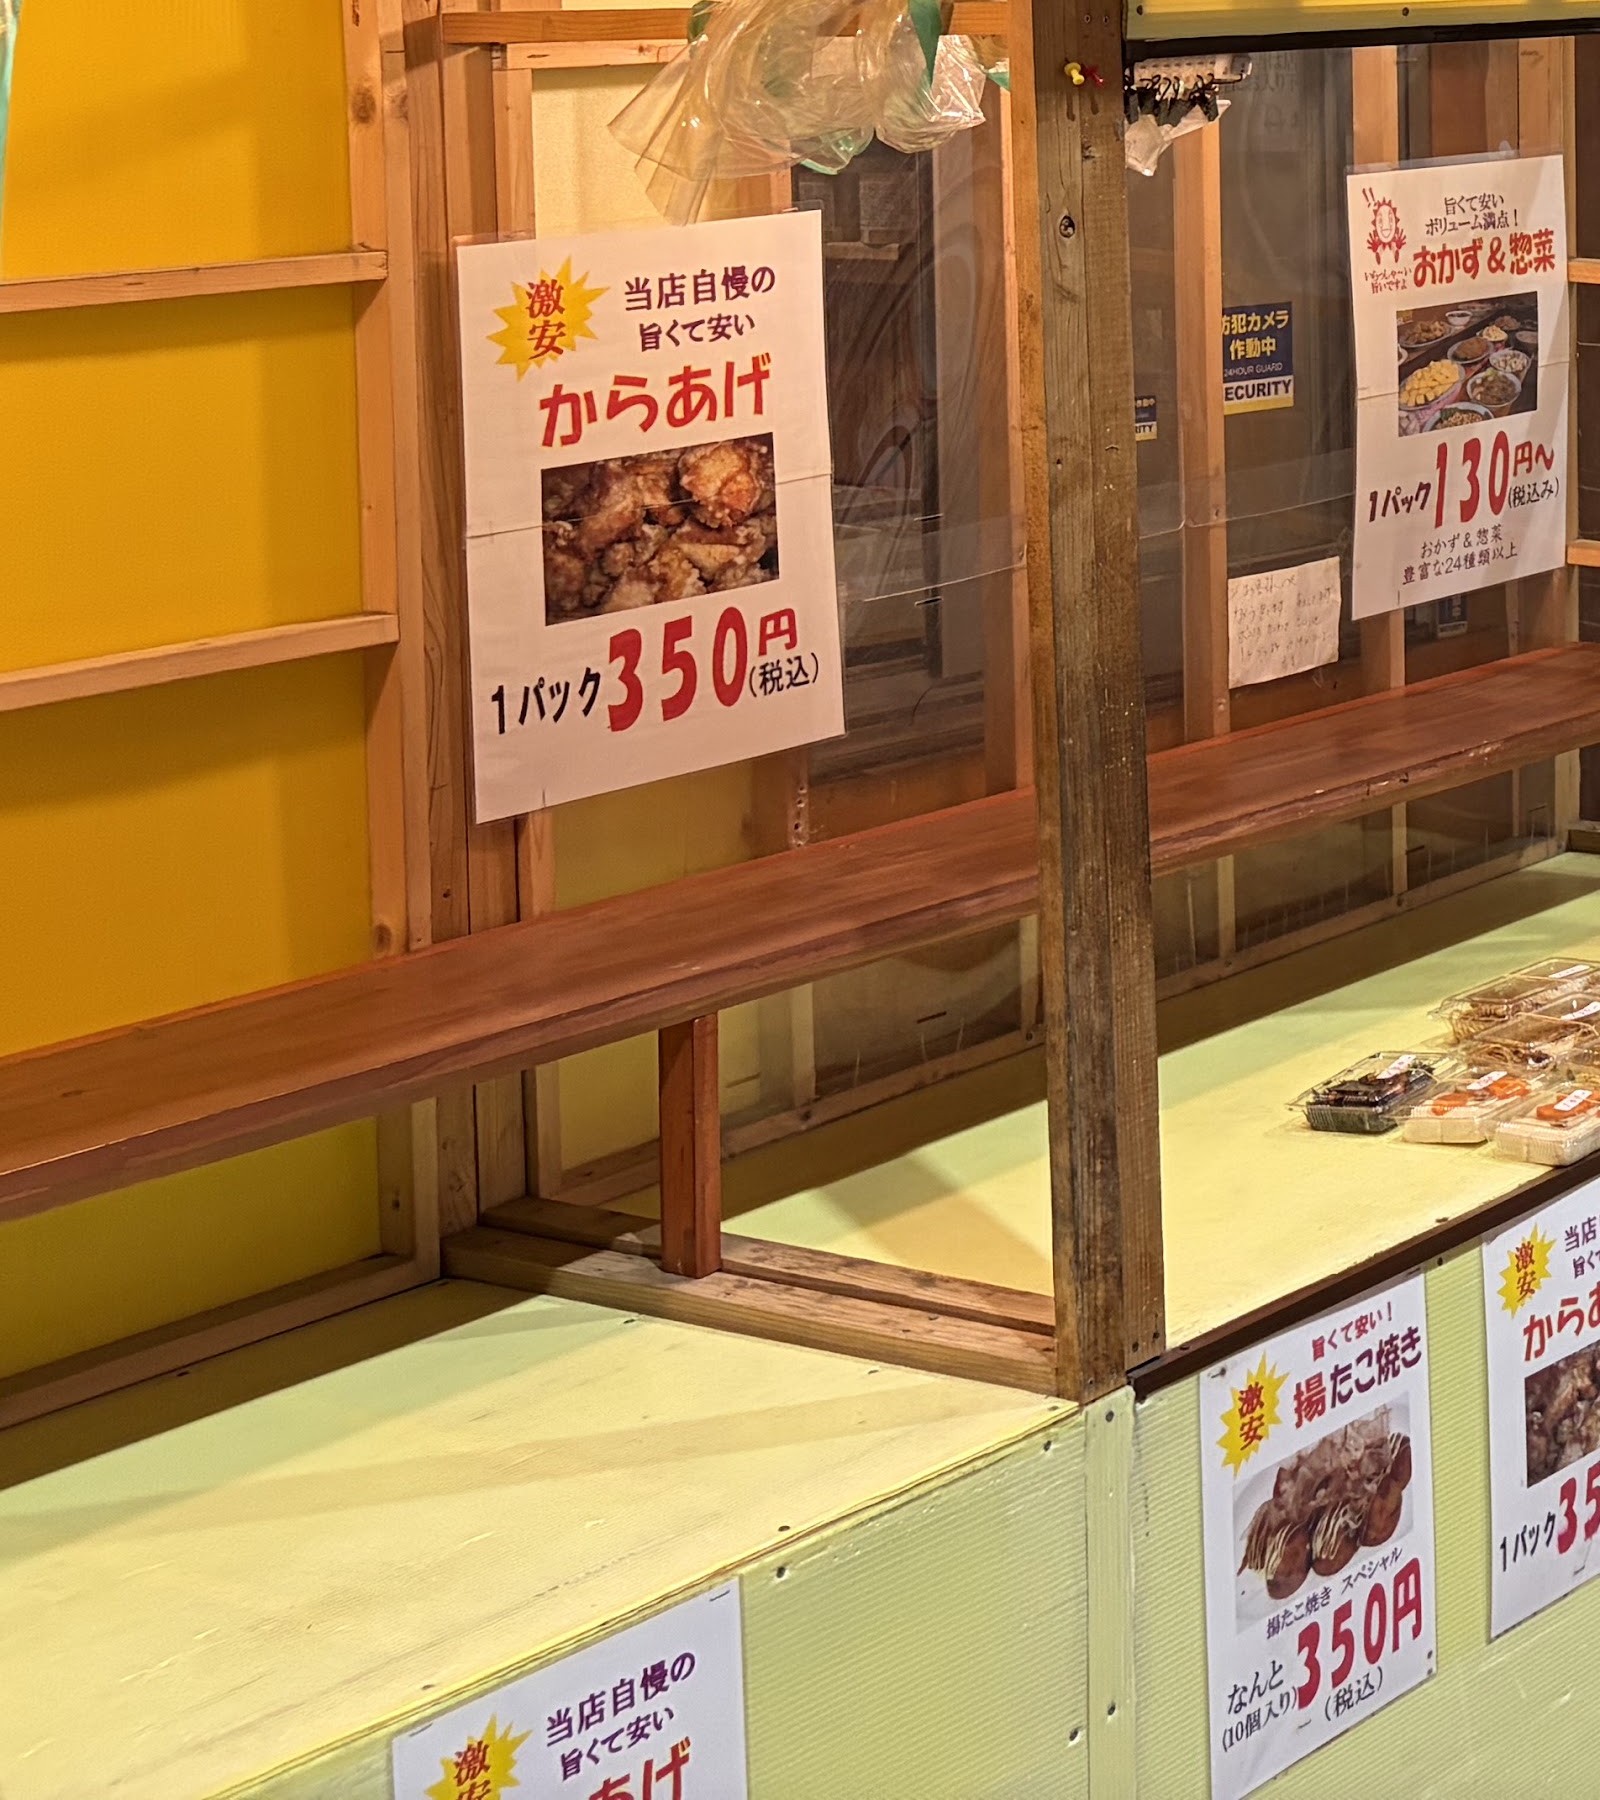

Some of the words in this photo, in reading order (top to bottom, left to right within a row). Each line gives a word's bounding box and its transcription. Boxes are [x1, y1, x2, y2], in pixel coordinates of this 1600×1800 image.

[1425, 209, 1518, 236] ボリューム満点！
[1444, 193, 1504, 215] 旨くて安い
[526, 279, 566, 358] 激安
[623, 264, 776, 312] 当店自慢の
[639, 313, 756, 352] 旨くて安い
[1230, 336, 1276, 360] 作動中
[540, 352, 772, 448] からあげ
[1225, 379, 1292, 401] ECURITY
[1369, 482, 1431, 522] 1パック
[1508, 477, 1559, 508] (税込み)
[1402, 542, 1517, 585] 豊富な24種類以上
[491, 667, 602, 736] 1パック
[608, 605, 797, 733] 350円
[749, 653, 820, 699] (税込)
[1514, 1240, 1538, 1301] 激安
[1312, 1301, 1395, 1359] 旨くて安い！
[1294, 1326, 1422, 1429] 揚たこ焼き
[1237, 1384, 1266, 1450] 激安
[1499, 1511, 1556, 1572] 1パック
[1266, 1585, 1332, 1640] 揚たこ焼き
[1341, 1546, 1403, 1594] スペシャル
[1227, 1660, 1284, 1716] なんと
[1297, 1557, 1422, 1710] 350円
[546, 1651, 696, 1747] 当店自慢の
[1324, 1666, 1384, 1724] (税込)
[560, 1707, 674, 1781] 旨くて安い
